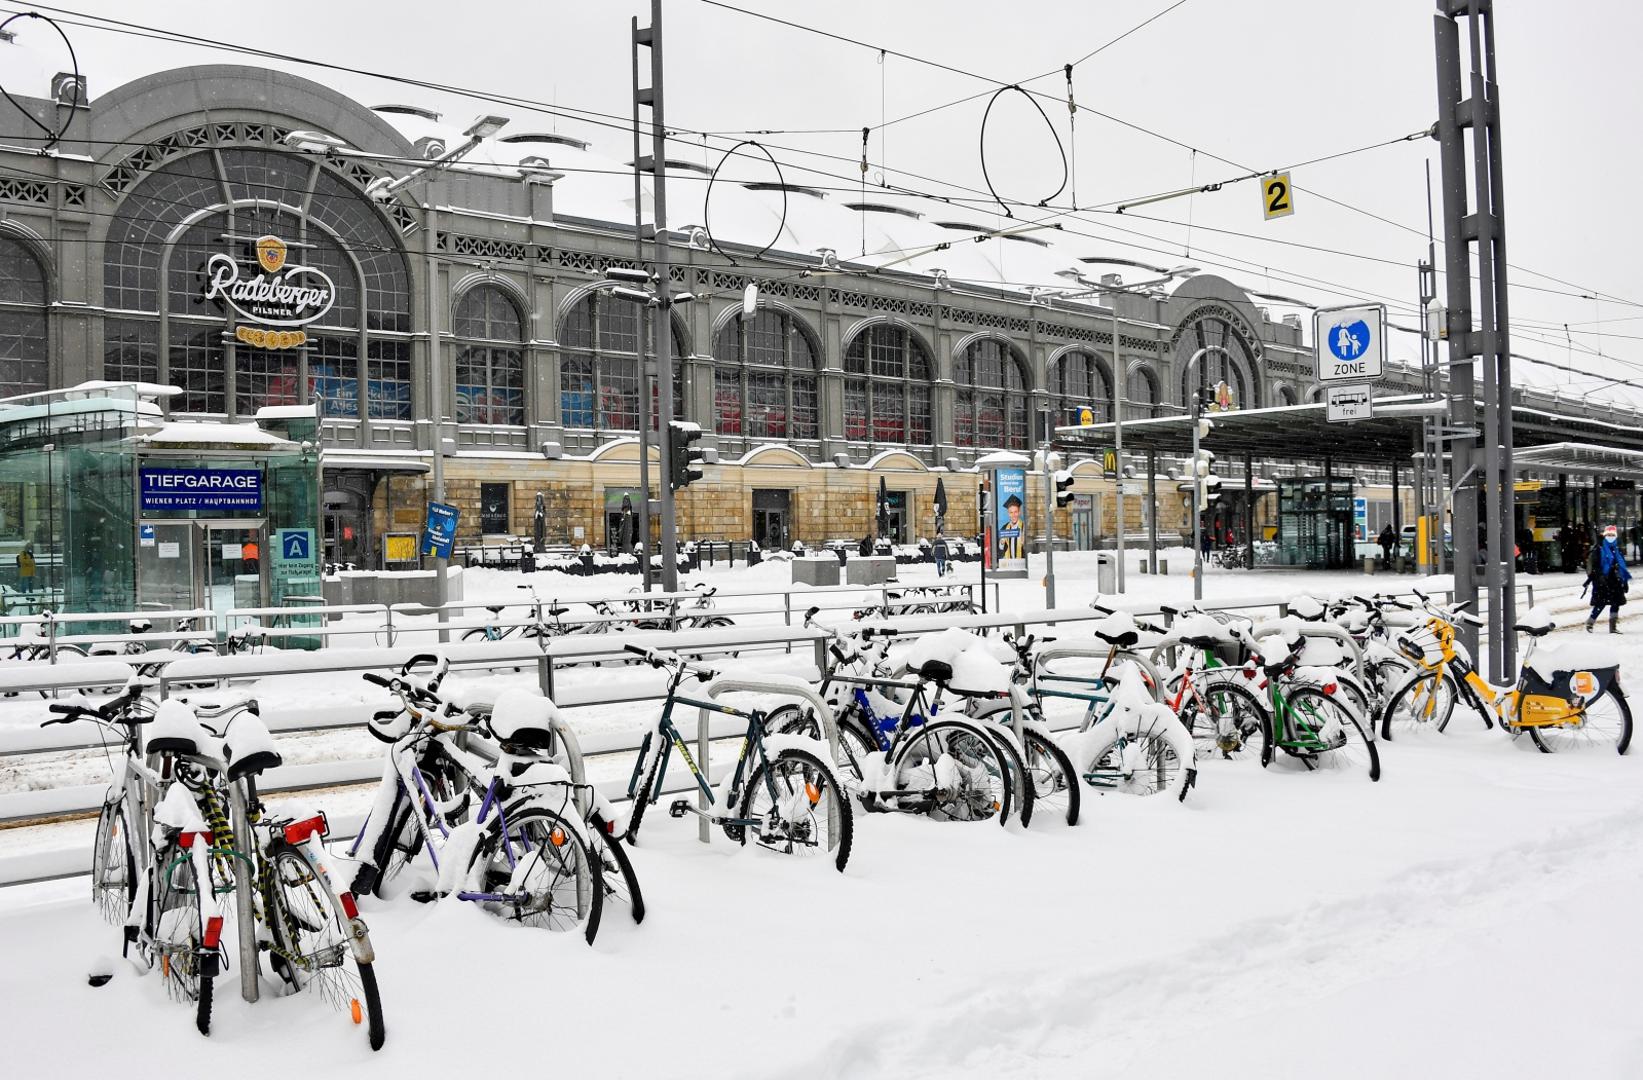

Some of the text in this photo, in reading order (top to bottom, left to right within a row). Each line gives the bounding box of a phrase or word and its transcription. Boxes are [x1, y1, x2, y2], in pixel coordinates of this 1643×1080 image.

[1268, 181, 1288, 212] 2
[205, 253, 334, 318] Radeberger
[252, 306, 293, 317] PILSNER
[1334, 363, 1366, 375] ZONE
[1342, 406, 1357, 416] frei
[145, 474, 257, 488] TIEFGARAGE
[204, 498, 258, 506] HAUPTBAHNHOF
[290, 540, 302, 556] A
